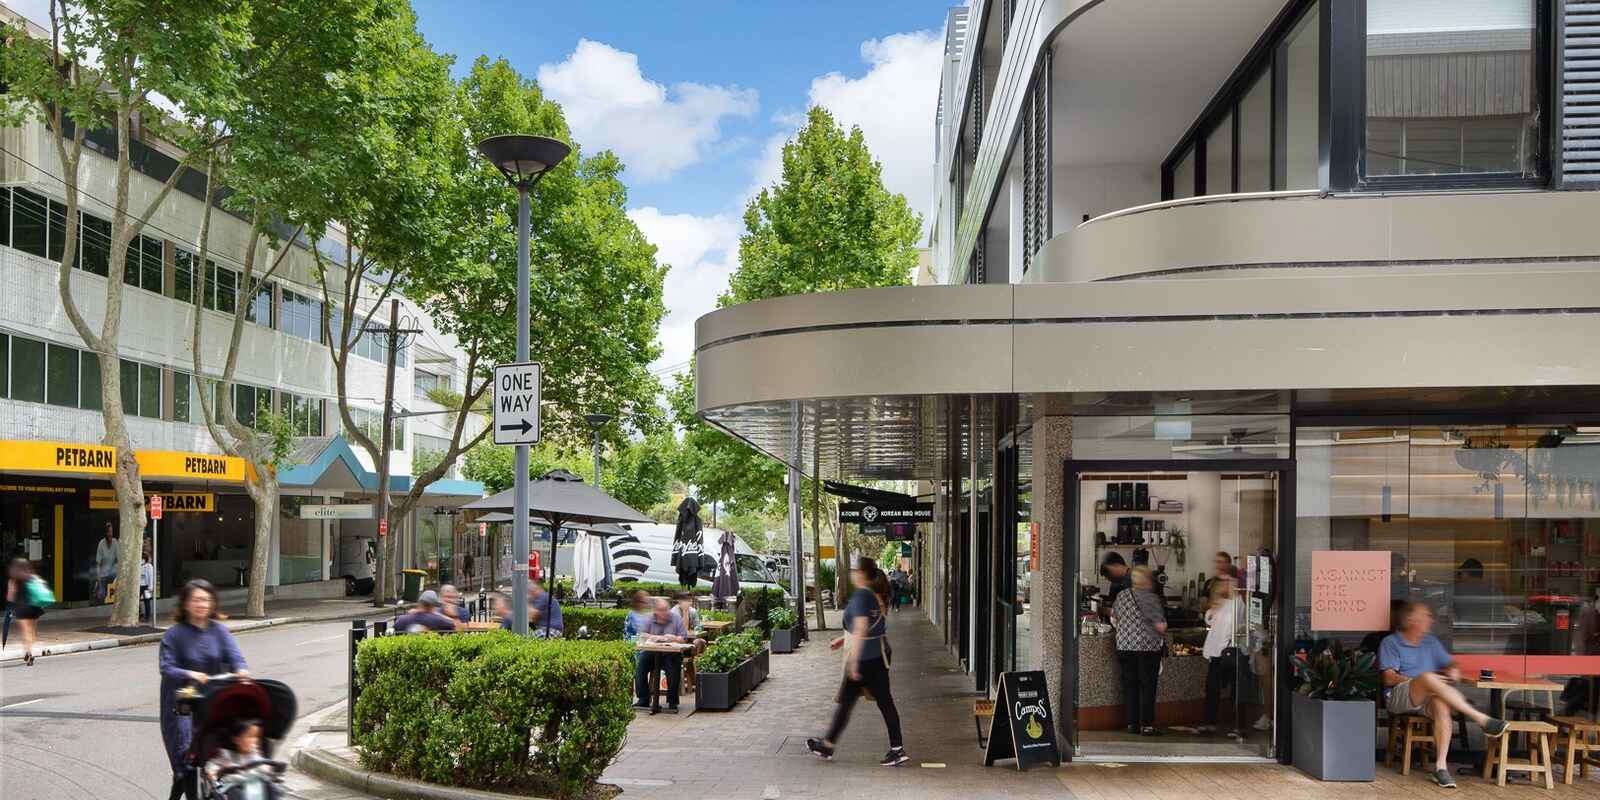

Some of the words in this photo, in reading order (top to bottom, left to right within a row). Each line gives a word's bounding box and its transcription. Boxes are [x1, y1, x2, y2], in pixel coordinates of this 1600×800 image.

[502, 372, 533, 392] ONE
[500, 394, 533, 413] WAY
[56, 447, 113, 469] PETBARN
[185, 457, 226, 475] PETBARN
[144, 495, 206, 510] PTBARN
[314, 507, 336, 517] elite
[1313, 568, 1387, 582] AGAINST
[1315, 584, 1348, 597] THE
[1315, 599, 1368, 613] GRIND
